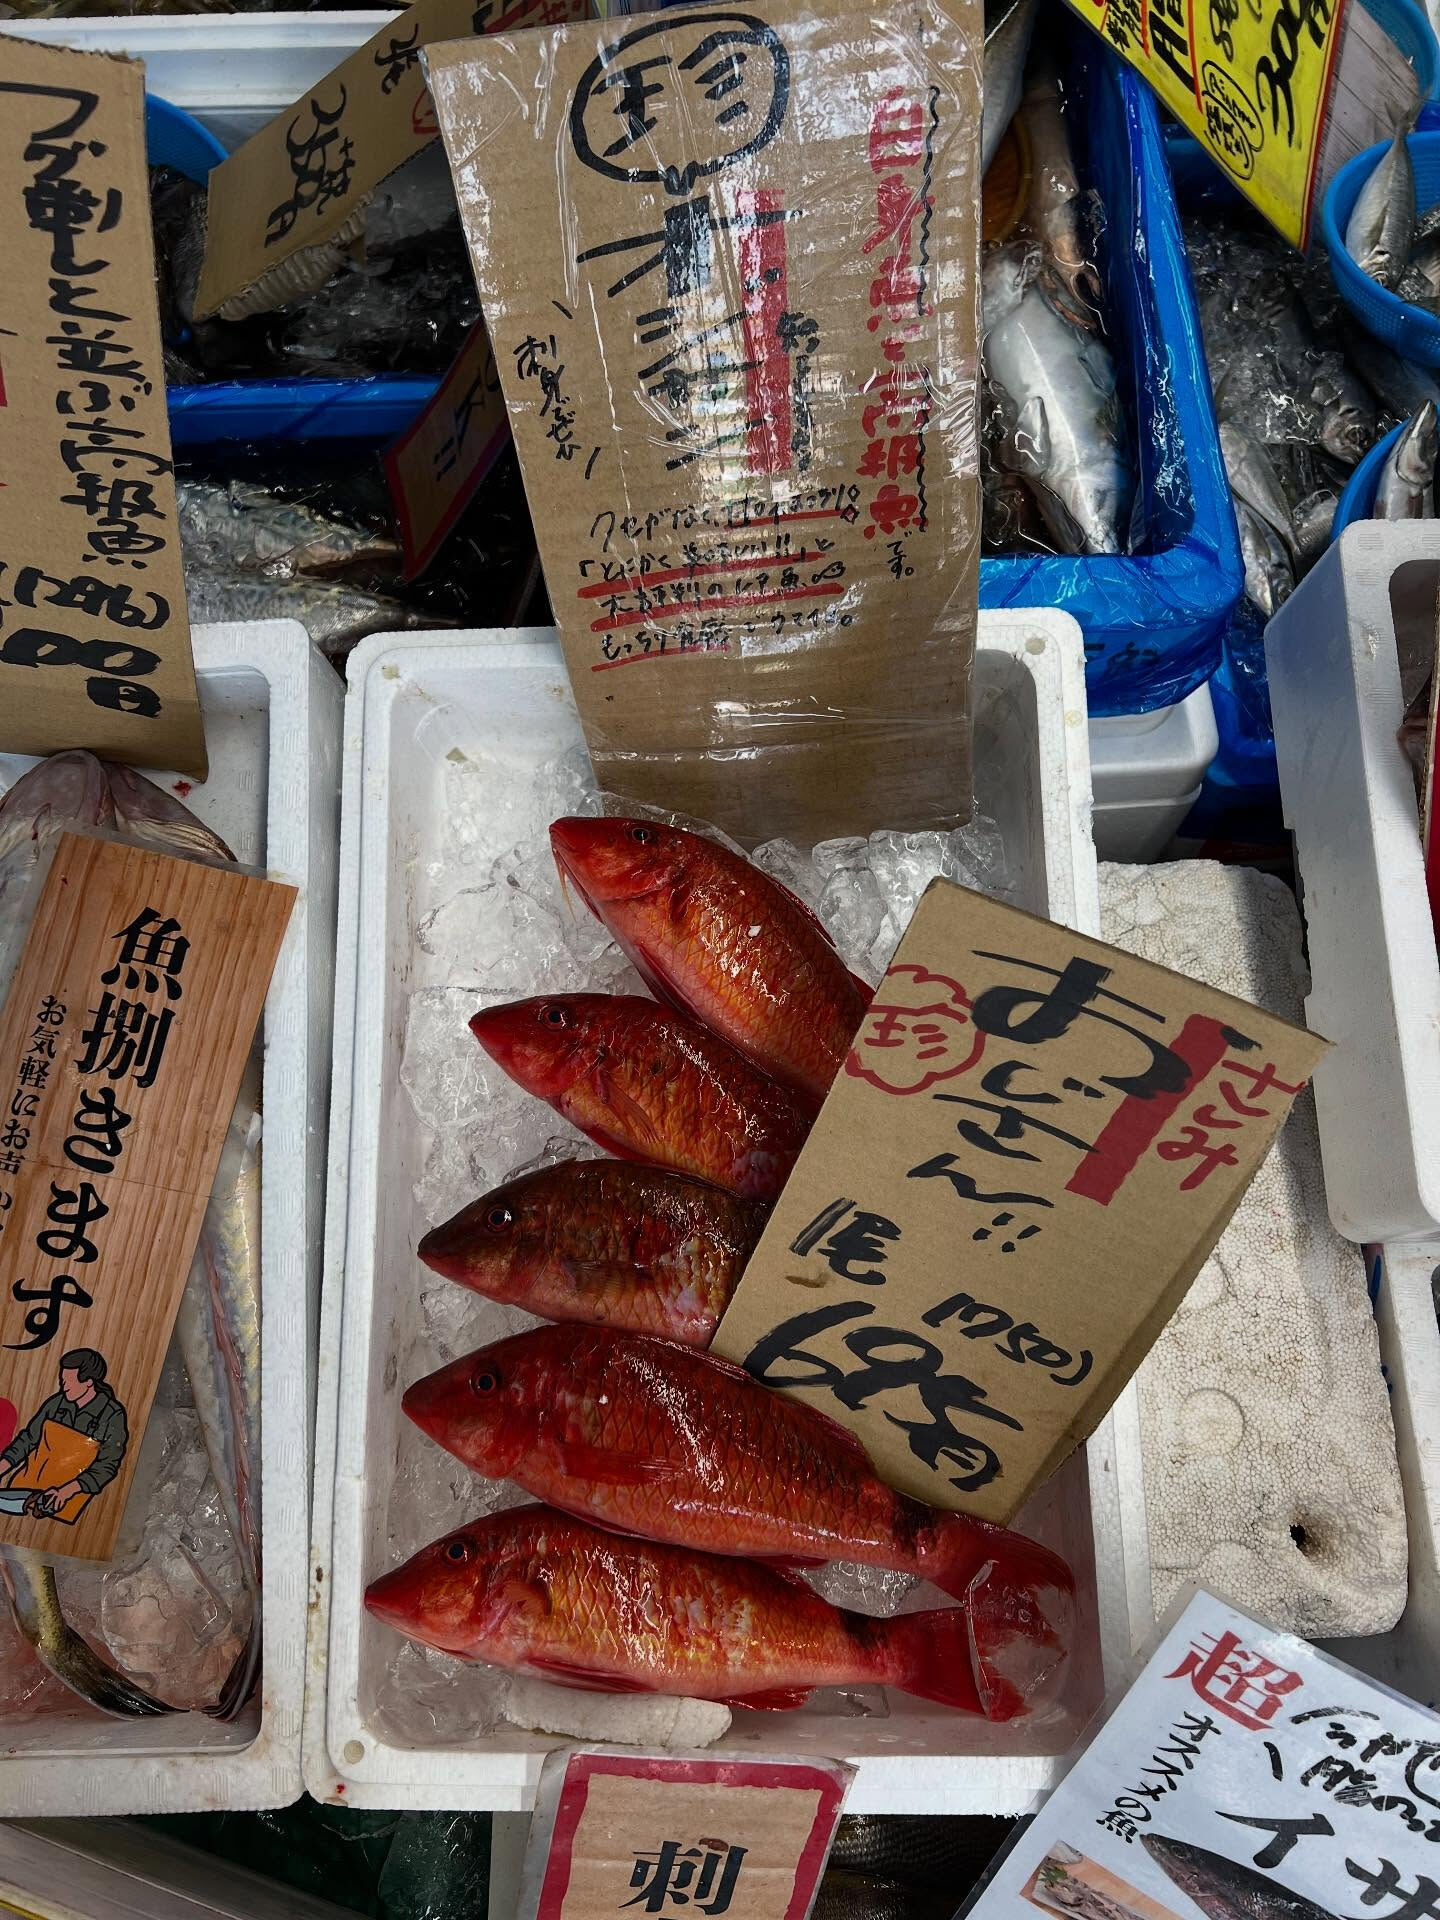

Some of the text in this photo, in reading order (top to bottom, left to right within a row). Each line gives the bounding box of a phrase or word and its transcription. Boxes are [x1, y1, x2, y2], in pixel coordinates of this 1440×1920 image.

[0, 994, 67, 1232] お気軽にお声
[2, 905, 193, 1352] 魚捌きます
[1163, 1630, 1305, 1731] 超
[1096, 1711, 1222, 1844] オススメの魚
[619, 1840, 749, 1916] 刺
